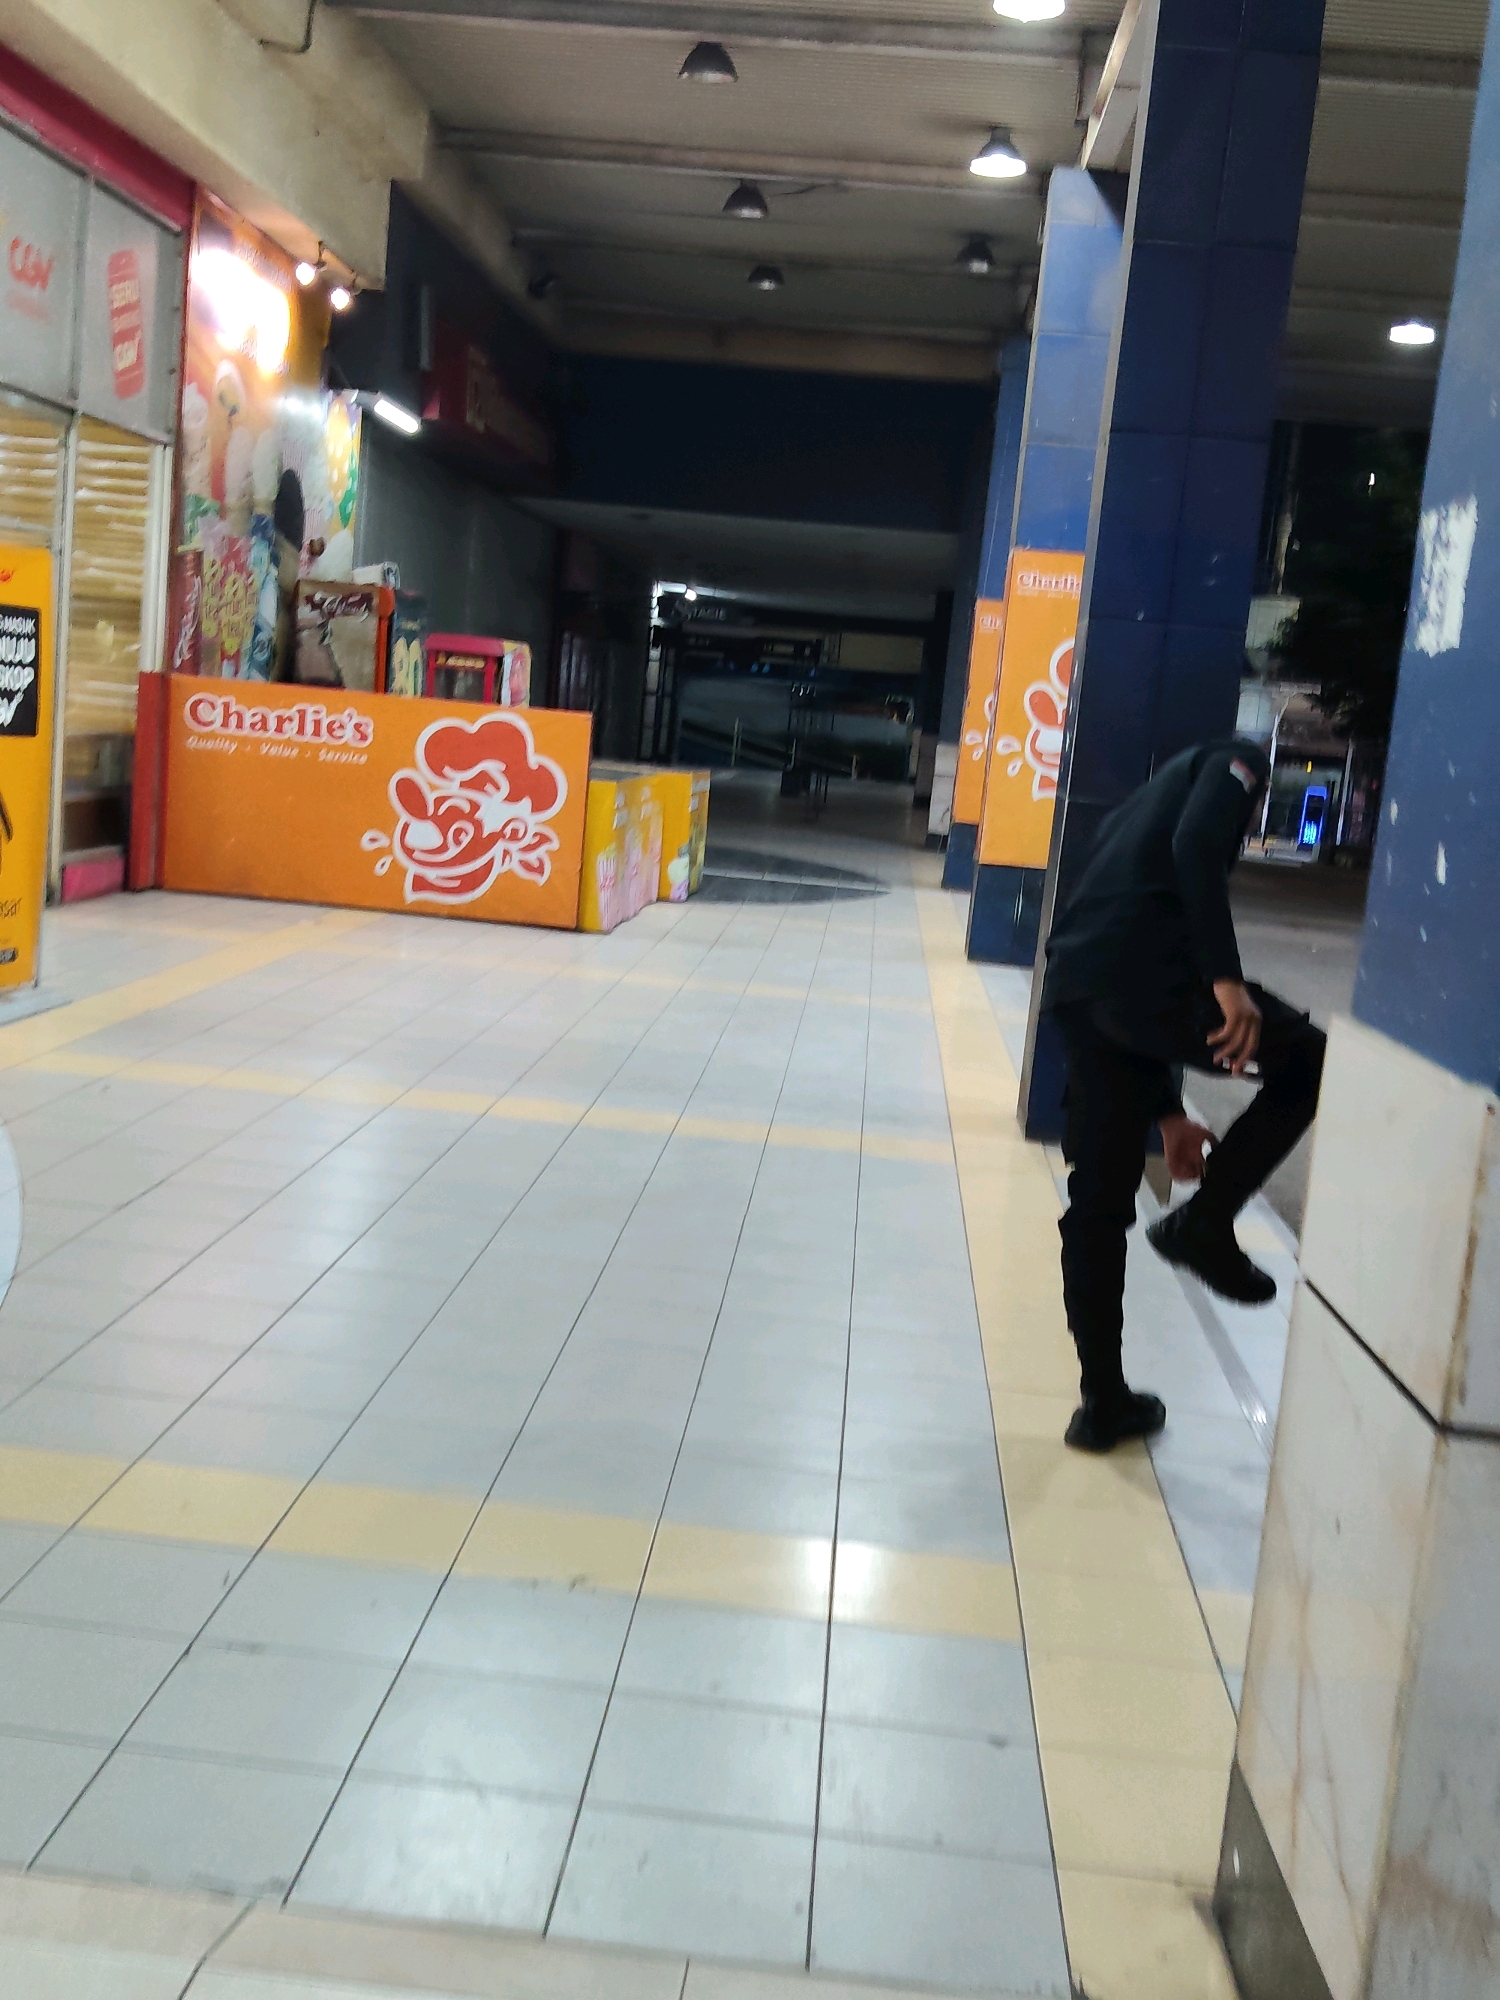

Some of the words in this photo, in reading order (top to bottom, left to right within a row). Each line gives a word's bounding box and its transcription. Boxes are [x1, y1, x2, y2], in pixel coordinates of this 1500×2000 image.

[185, 693, 373, 747] Charlie's
[185, 735, 237, 754] Quality
[260, 741, 300, 759] Value
[318, 748, 369, 765] Service
